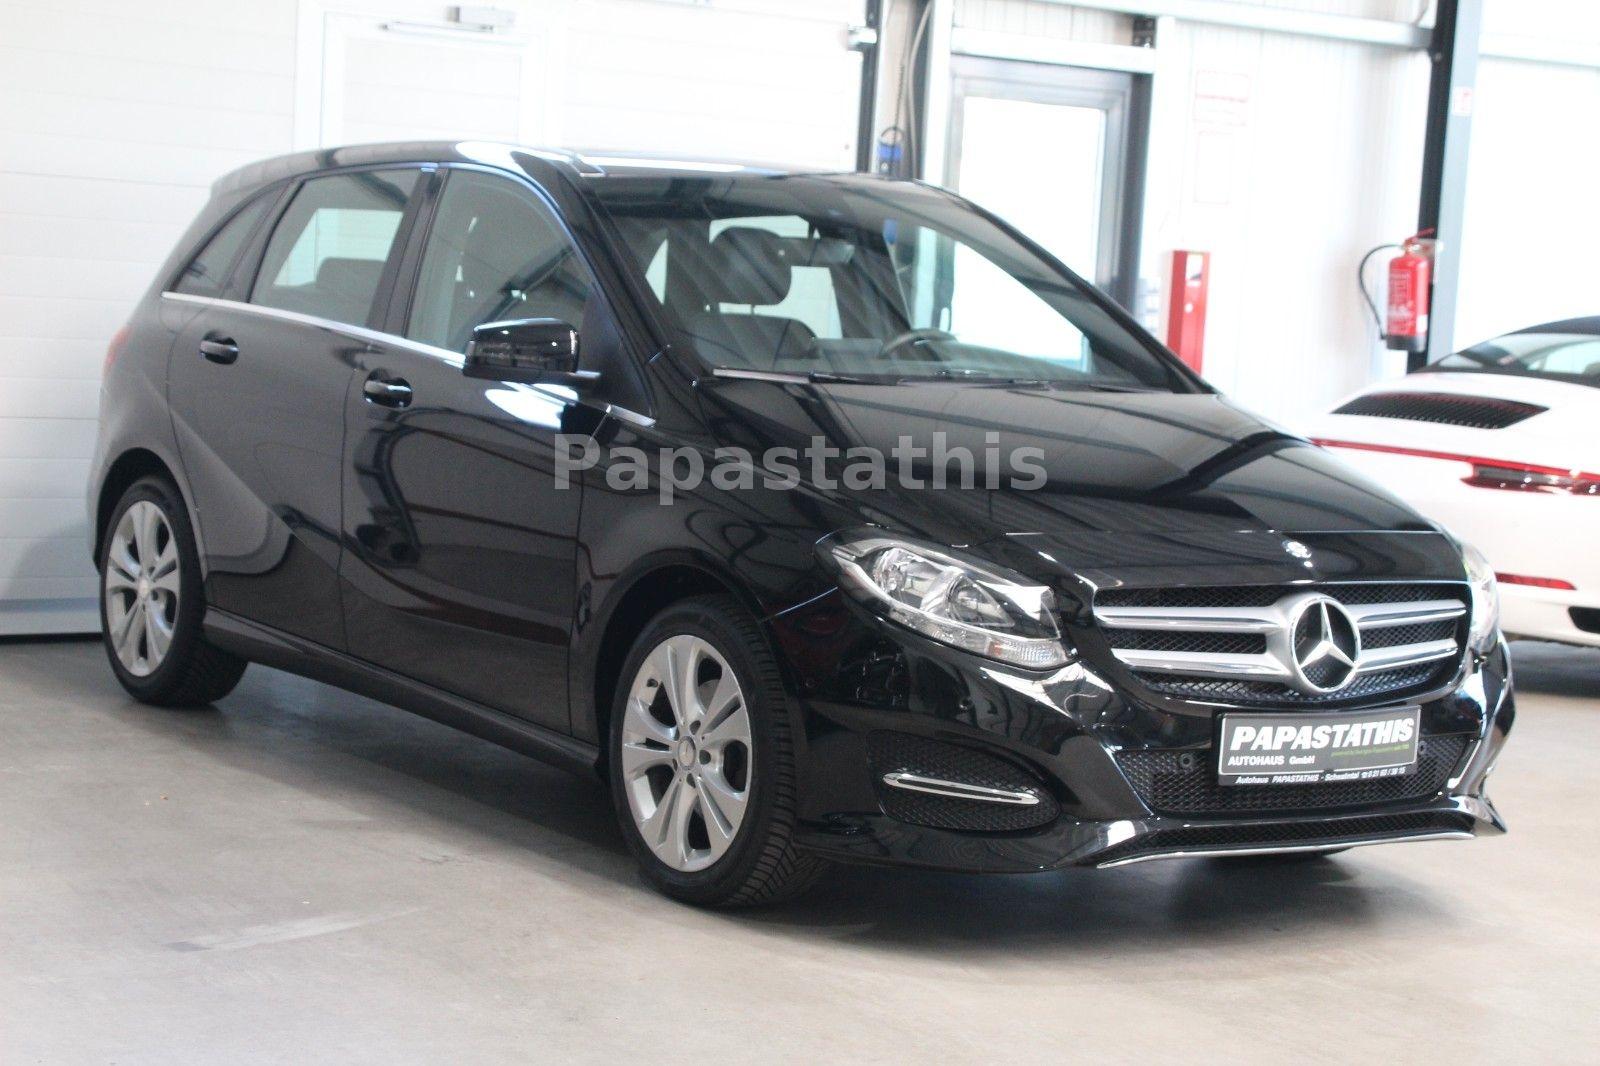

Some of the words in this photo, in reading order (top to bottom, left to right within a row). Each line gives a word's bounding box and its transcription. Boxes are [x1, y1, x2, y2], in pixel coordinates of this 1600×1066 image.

[1230, 717, 1414, 751] PAPASTATHIS
[1228, 755, 1285, 766] AUTOHAUS
[1289, 755, 1315, 765] GmbH
[1235, 775, 1269, 784] Autohaus
[1272, 773, 1319, 784] PAPASTATHIS
